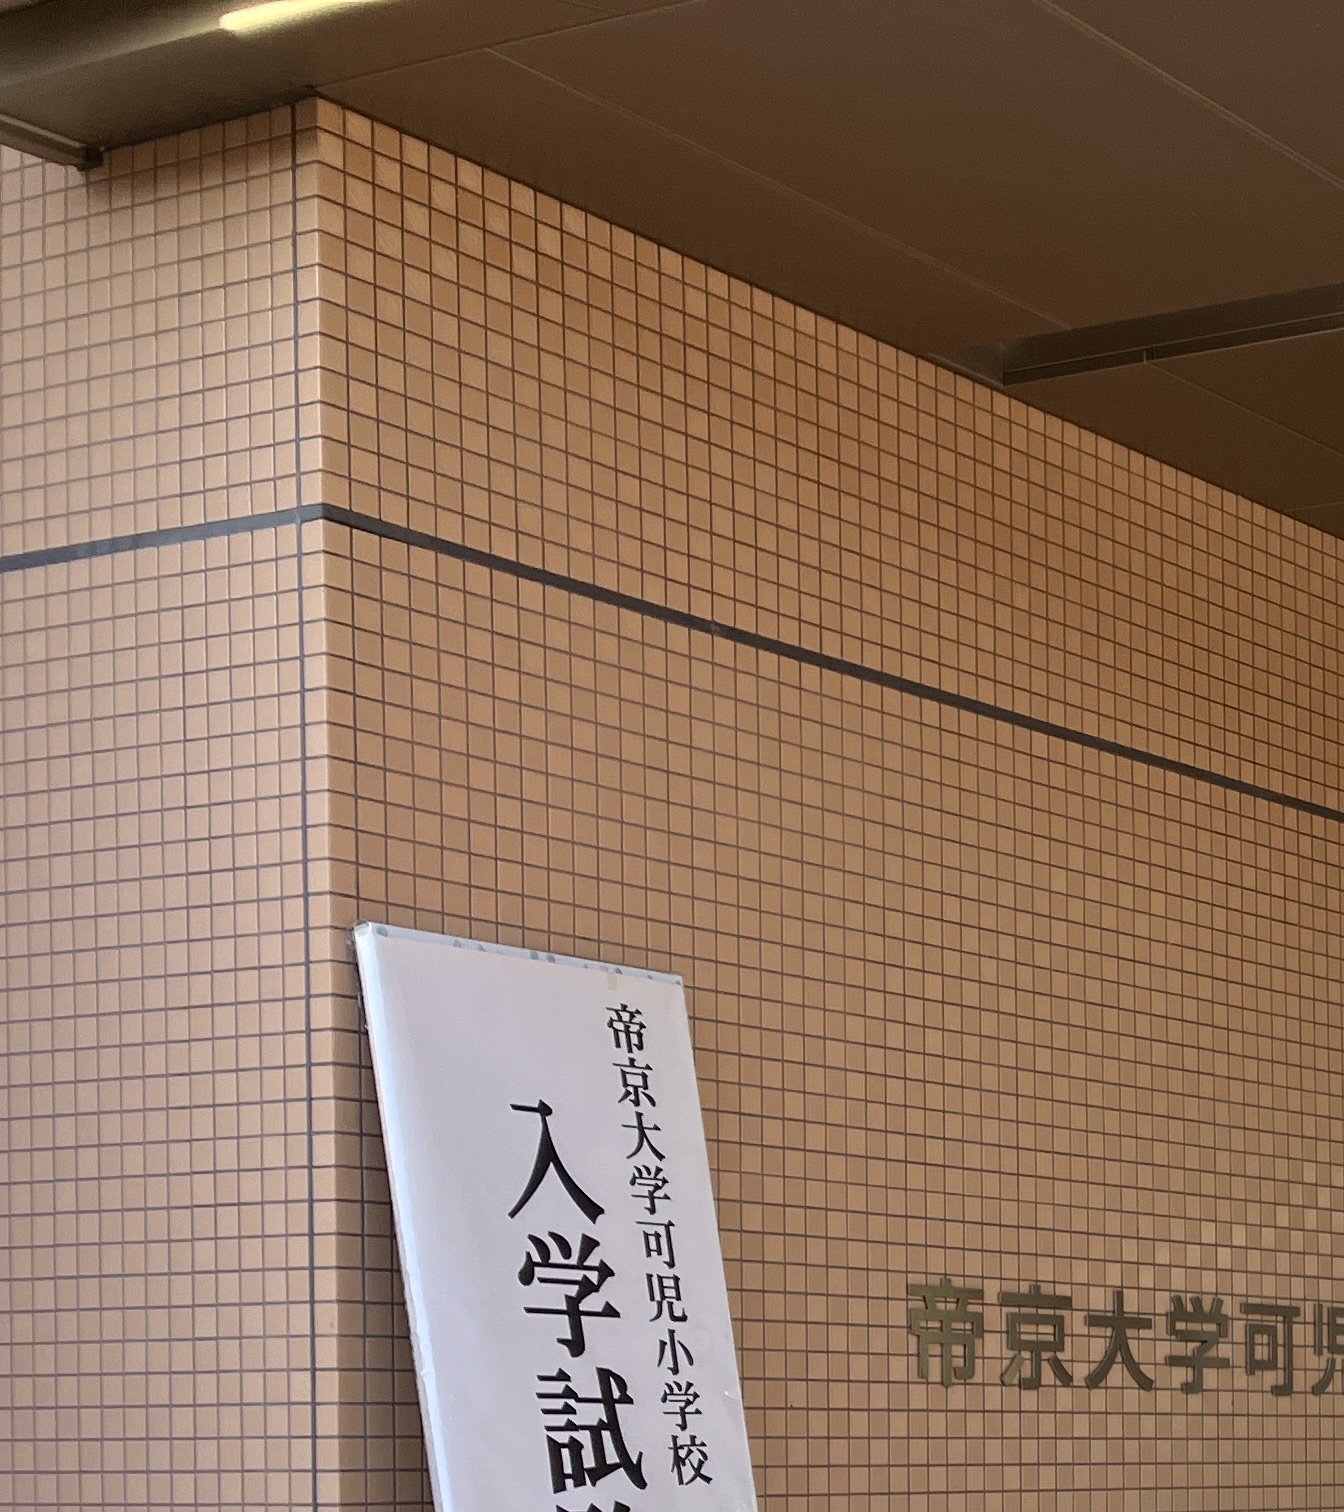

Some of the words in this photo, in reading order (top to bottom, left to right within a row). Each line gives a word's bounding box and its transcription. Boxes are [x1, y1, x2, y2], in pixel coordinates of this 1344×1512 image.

[605, 1002, 713, 1487] 帝京大学可児小学校
